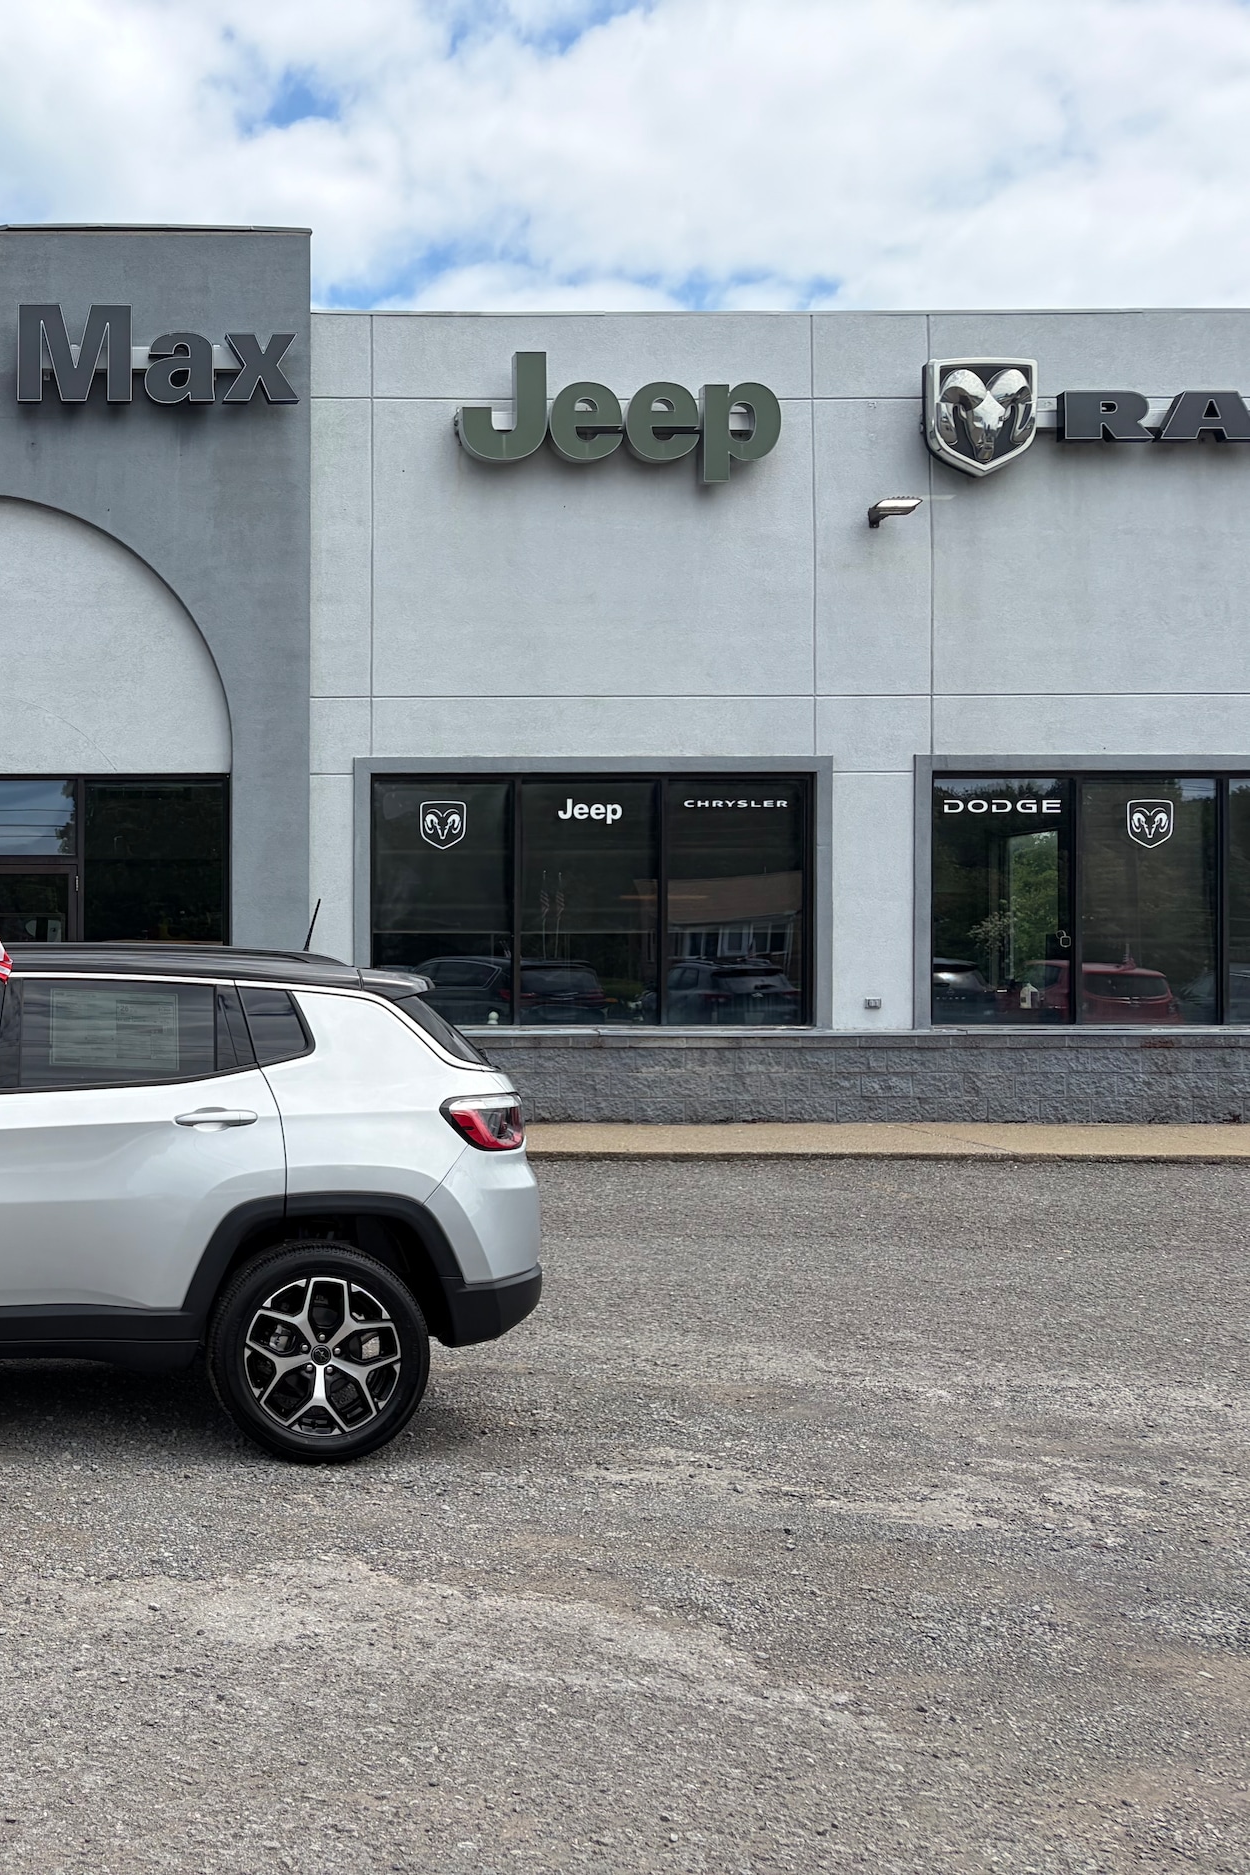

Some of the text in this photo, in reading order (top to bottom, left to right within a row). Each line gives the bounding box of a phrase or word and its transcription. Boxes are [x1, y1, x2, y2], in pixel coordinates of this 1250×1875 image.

[16, 303, 301, 405] Max
[457, 351, 782, 483] Jeep
[558, 798, 623, 825] Jeep
[683, 799, 789, 808] CHRYSLER
[943, 800, 1062, 813] DODGE
